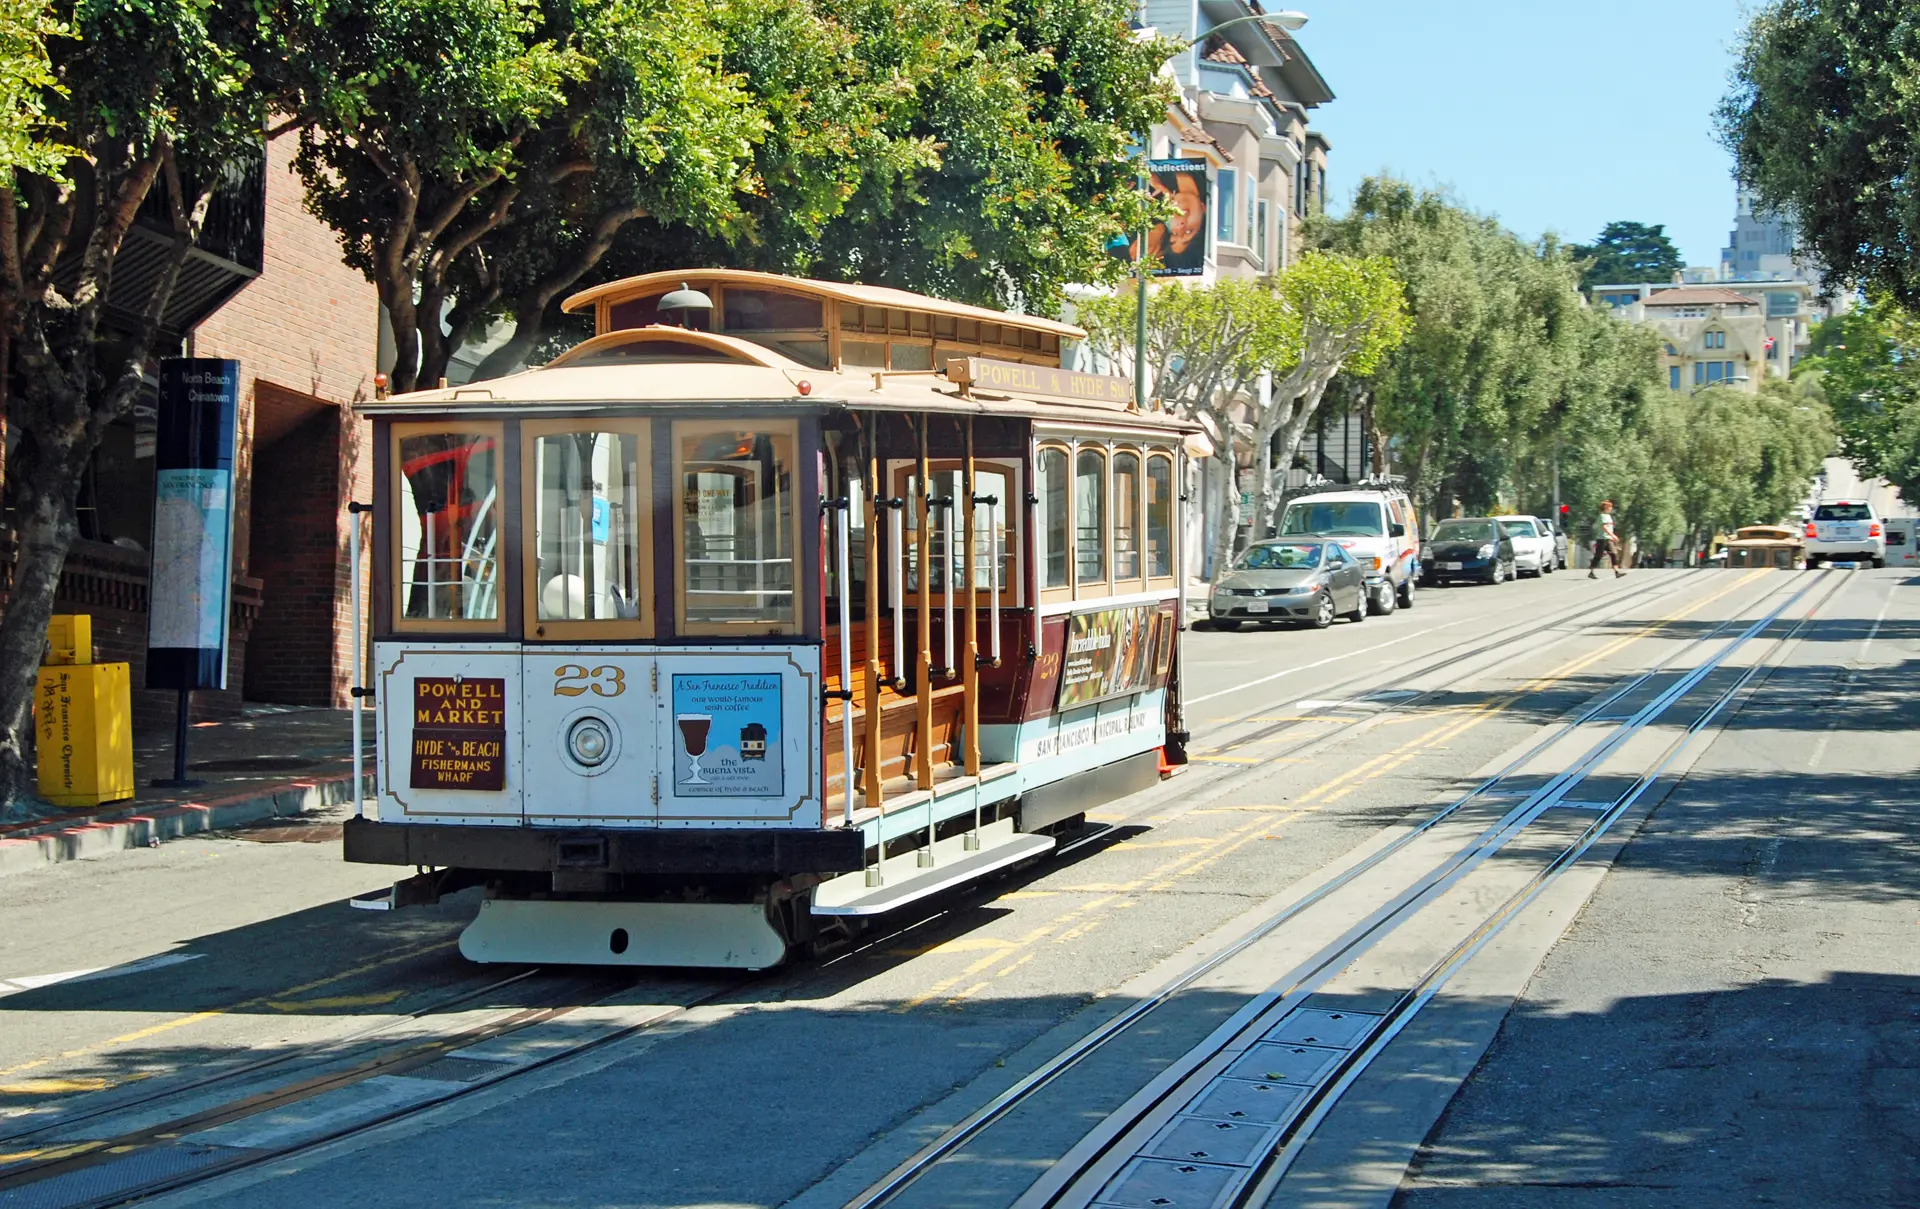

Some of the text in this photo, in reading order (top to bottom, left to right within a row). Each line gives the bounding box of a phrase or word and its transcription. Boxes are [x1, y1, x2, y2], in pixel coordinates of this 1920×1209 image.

[1150, 164, 1206, 173] Reflections
[181, 371, 231, 385] North Beach
[980, 363, 1041, 390] POWELL
[1051, 374, 1061, 393] &
[1070, 375, 1104, 397] HYDE
[188, 389, 230, 403] Chinatown
[175, 481, 217, 489] FRANCSCO
[1041, 652, 1059, 680] 23
[554, 664, 626, 697] 23
[675, 679, 778, 692] A San Francisco Tradition
[418, 683, 501, 698] POWELL
[440, 698, 482, 709] AND
[417, 709, 503, 724] MARKET
[60, 672, 73, 789] San Francisco Chronicle
[1036, 738, 1052, 757] SAN
[1091, 719, 1123, 743] MUNICIPAL
[1124, 712, 1146, 732] RILWAY
[415, 740, 500, 758] HYDE AND BEACH
[421, 759, 491, 772] FISHERMANS
[437, 772, 474, 783] WHARF
[715, 785, 723, 793] of
